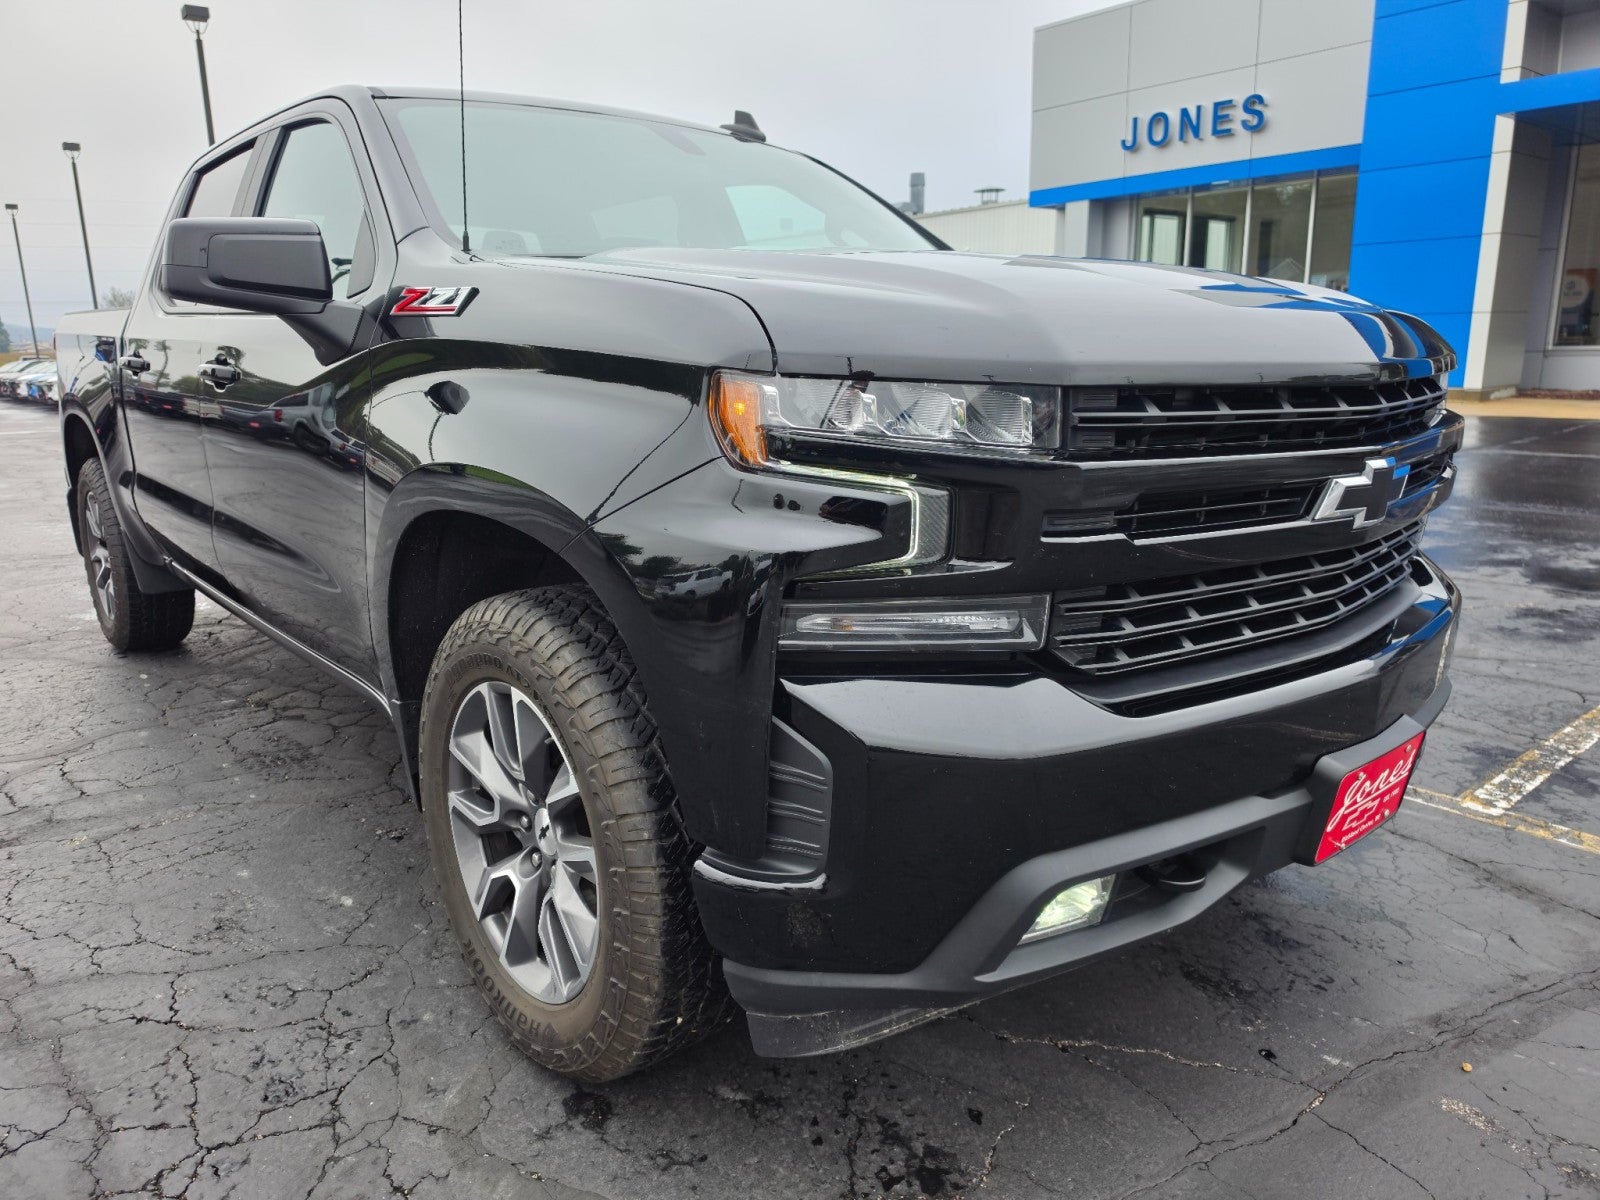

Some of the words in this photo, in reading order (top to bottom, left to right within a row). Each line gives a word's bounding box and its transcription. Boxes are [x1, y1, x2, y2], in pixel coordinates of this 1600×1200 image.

[1121, 93, 1266, 152] JONES
[390, 286, 474, 317] Z71
[1327, 749, 1416, 832] Jones
